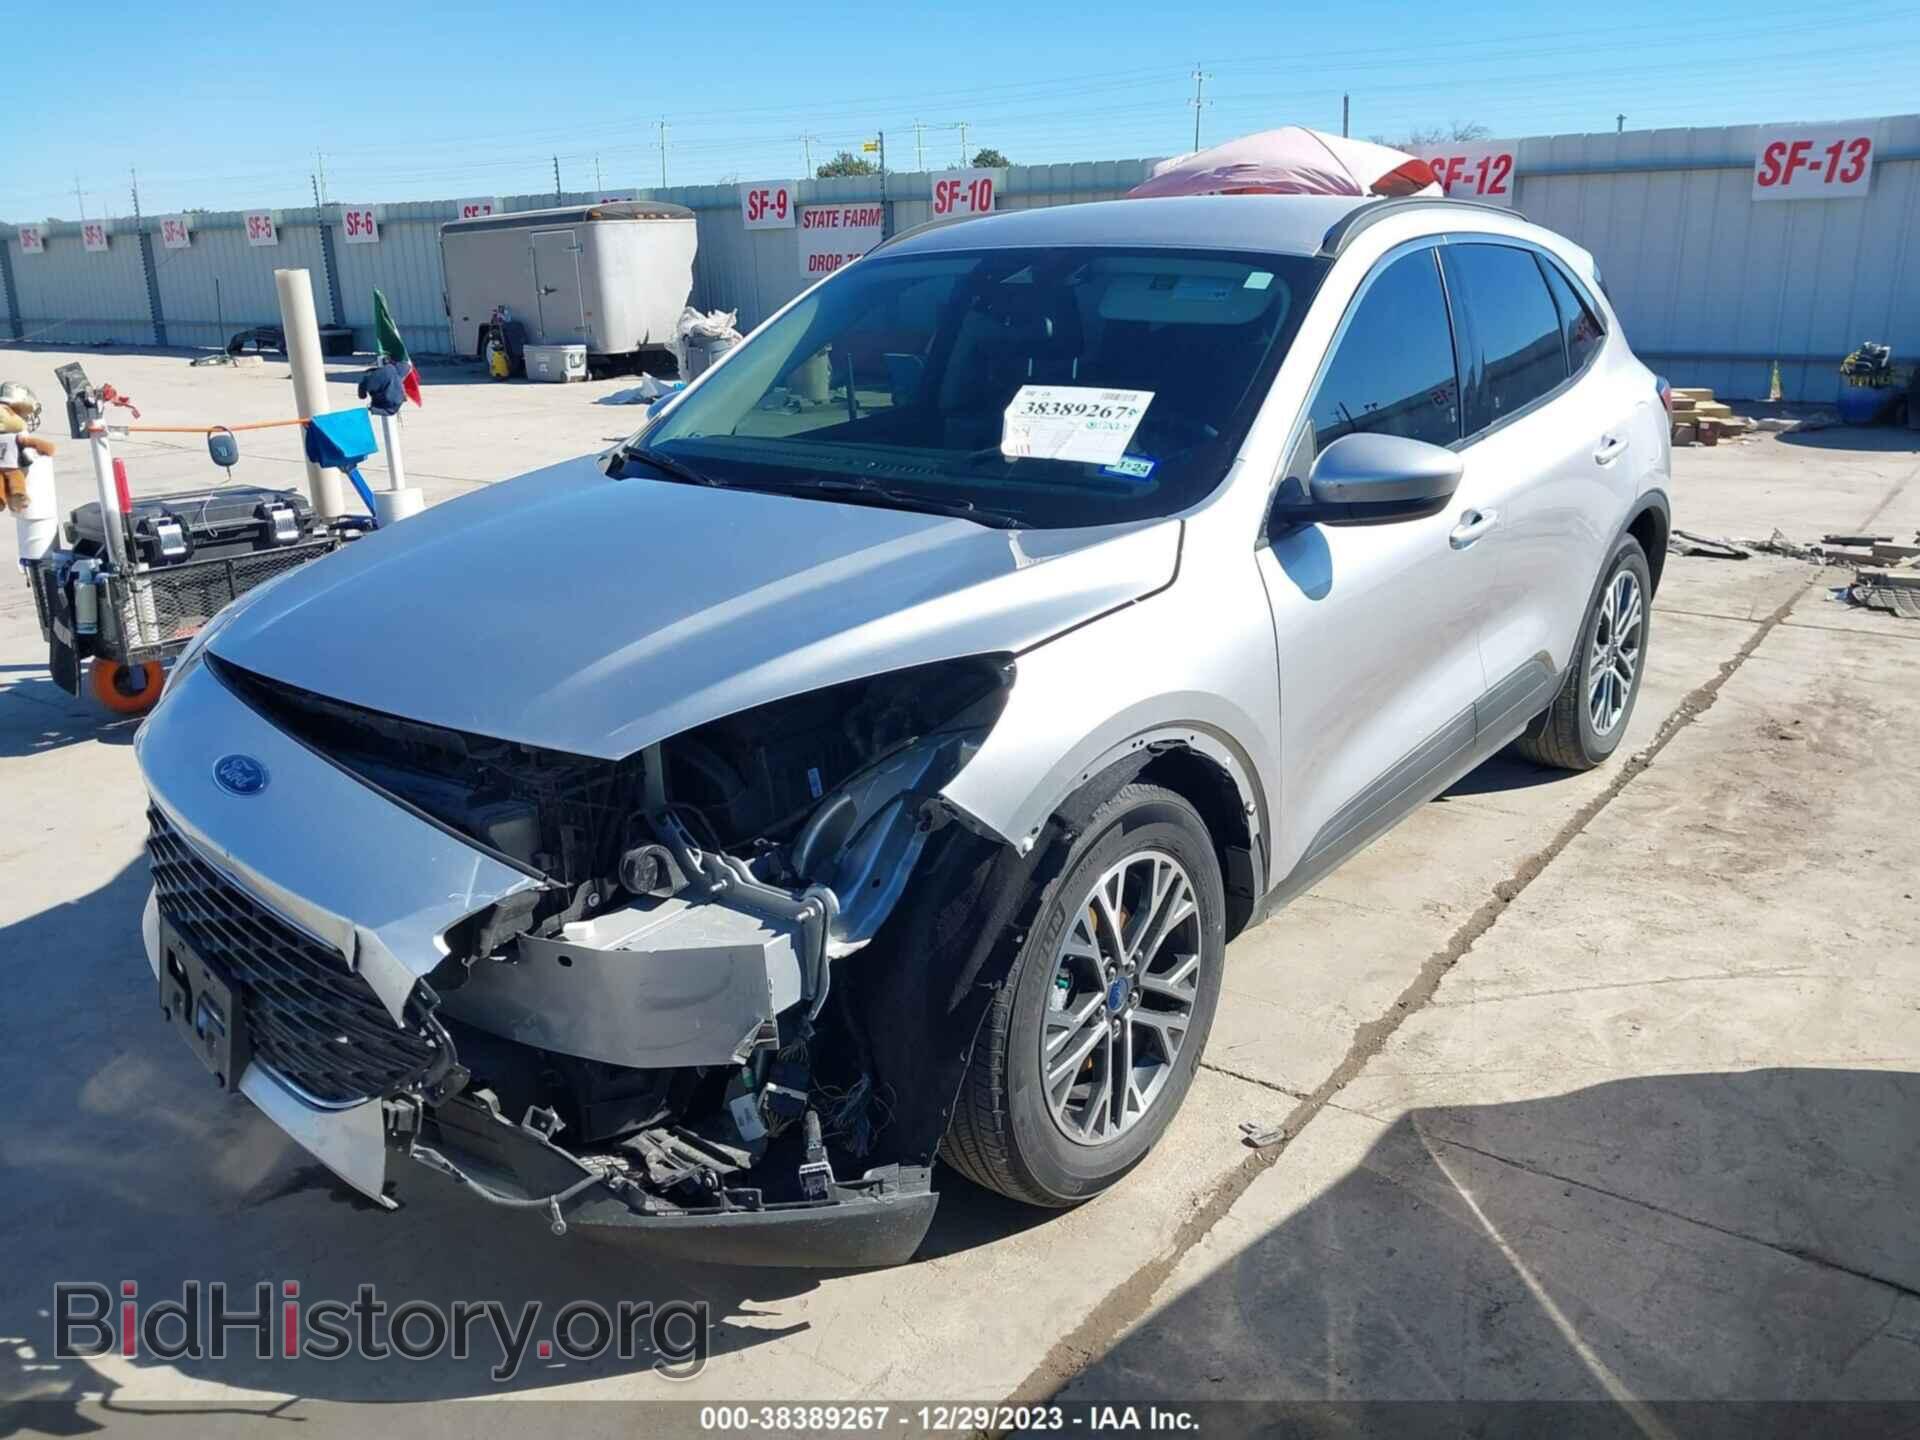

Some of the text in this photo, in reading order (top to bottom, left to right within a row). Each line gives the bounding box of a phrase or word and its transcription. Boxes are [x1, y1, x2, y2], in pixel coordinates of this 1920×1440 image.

[1427, 153, 1513, 196] SF-12
[1757, 137, 1871, 187] SF-13
[748, 189, 788, 221] SF-9
[934, 178, 993, 215] SF-10
[163, 220, 185, 242] SF-4
[248, 215, 272, 240] SF-5
[346, 211, 373, 236] SF-6
[803, 207, 880, 230] STATE FARM
[808, 254, 842, 272] DROP
[1021, 401, 1129, 420] 38389267
